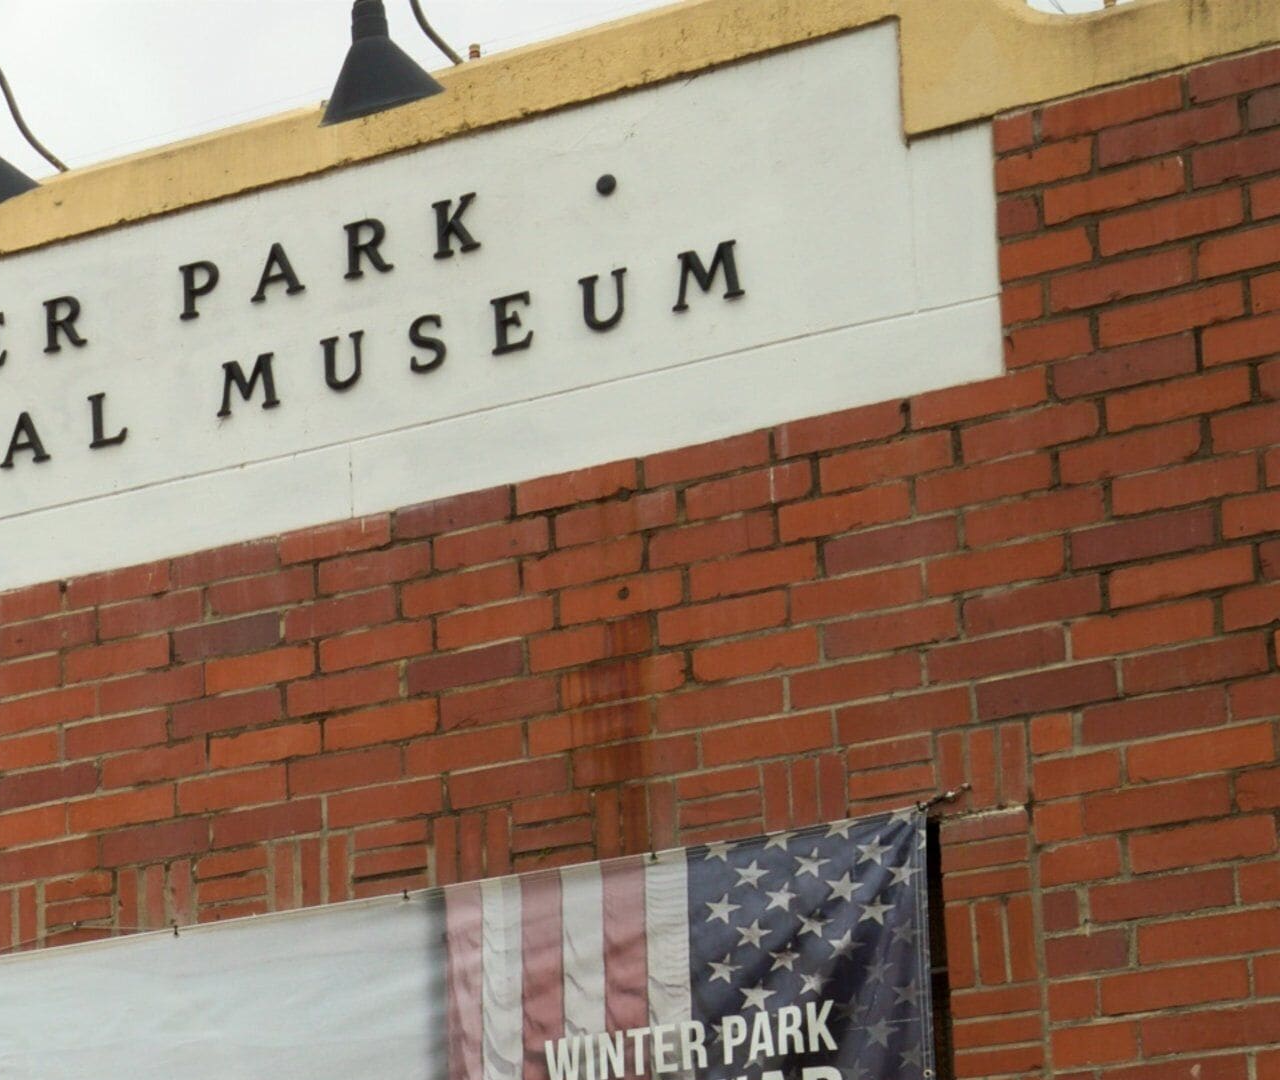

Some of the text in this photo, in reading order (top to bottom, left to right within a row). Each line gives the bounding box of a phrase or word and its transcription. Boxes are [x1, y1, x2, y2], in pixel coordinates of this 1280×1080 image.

[178, 192, 481, 320] PARK
[215, 238, 746, 418] MUSEUM
[722, 999, 838, 1065] PARK
